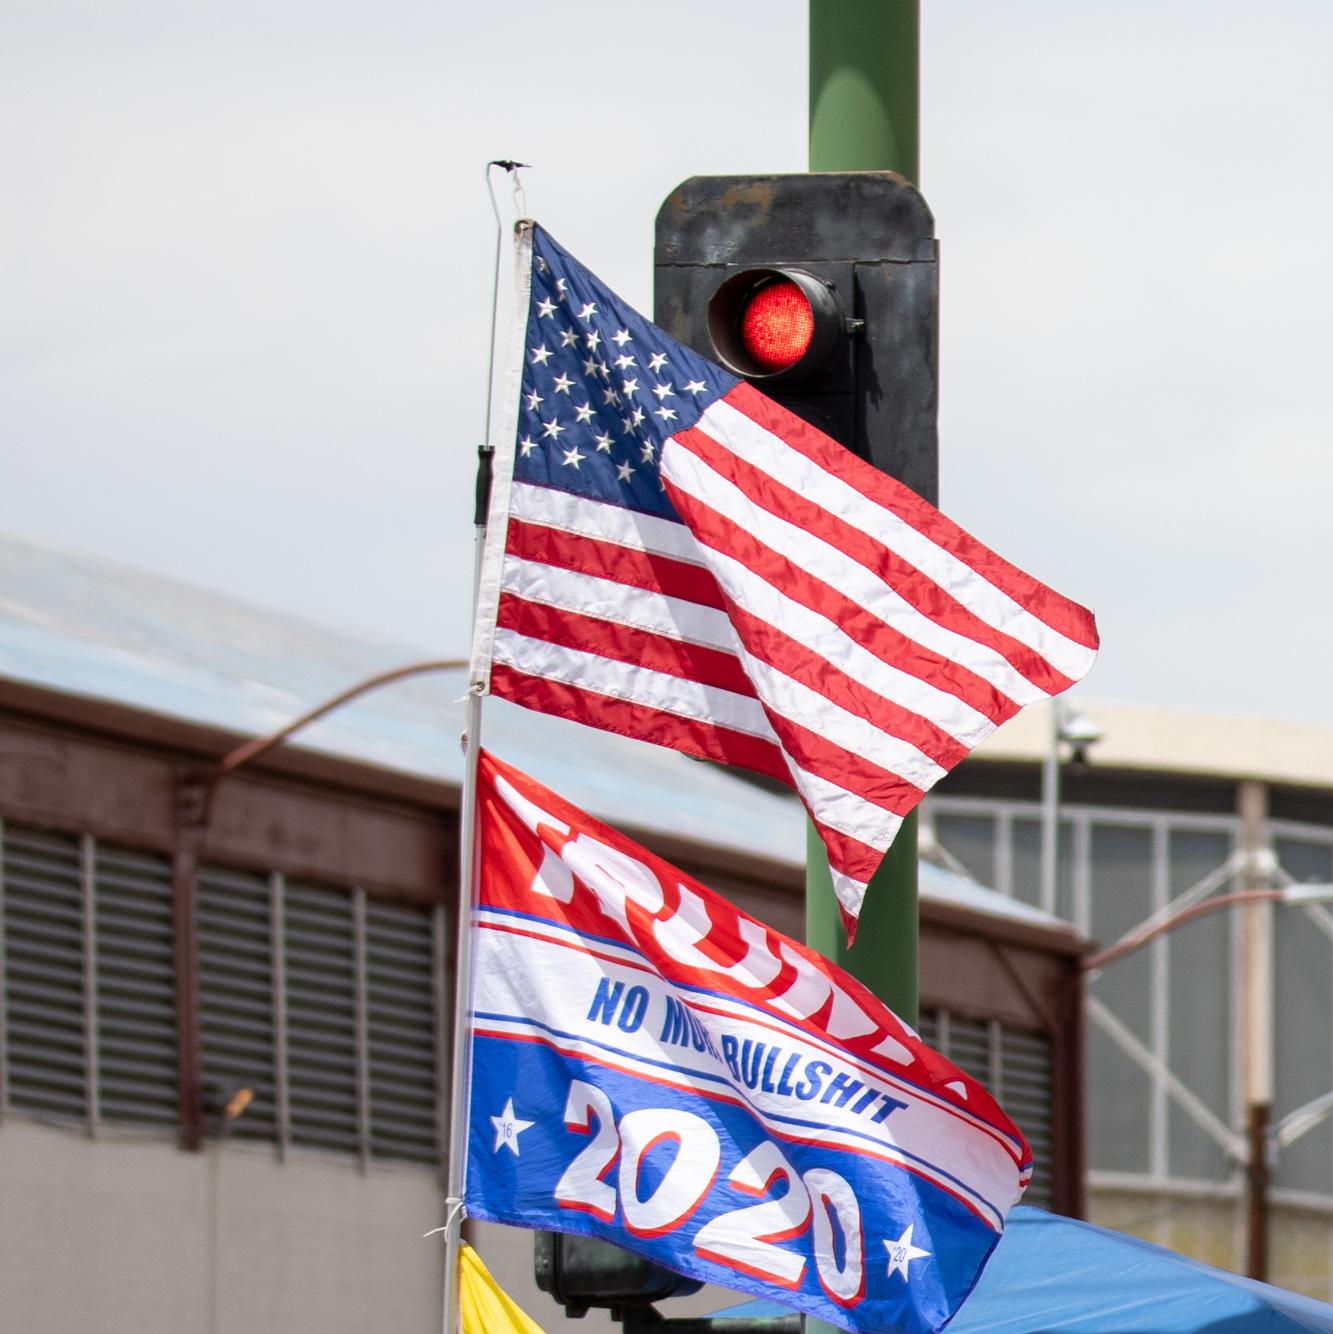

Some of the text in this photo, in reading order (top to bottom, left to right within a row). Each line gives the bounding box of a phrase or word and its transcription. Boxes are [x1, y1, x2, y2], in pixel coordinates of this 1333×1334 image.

[586, 976, 648, 1033] NO
[721, 1033, 908, 1123] BULLSHIT
[555, 1080, 866, 1308] 2020
